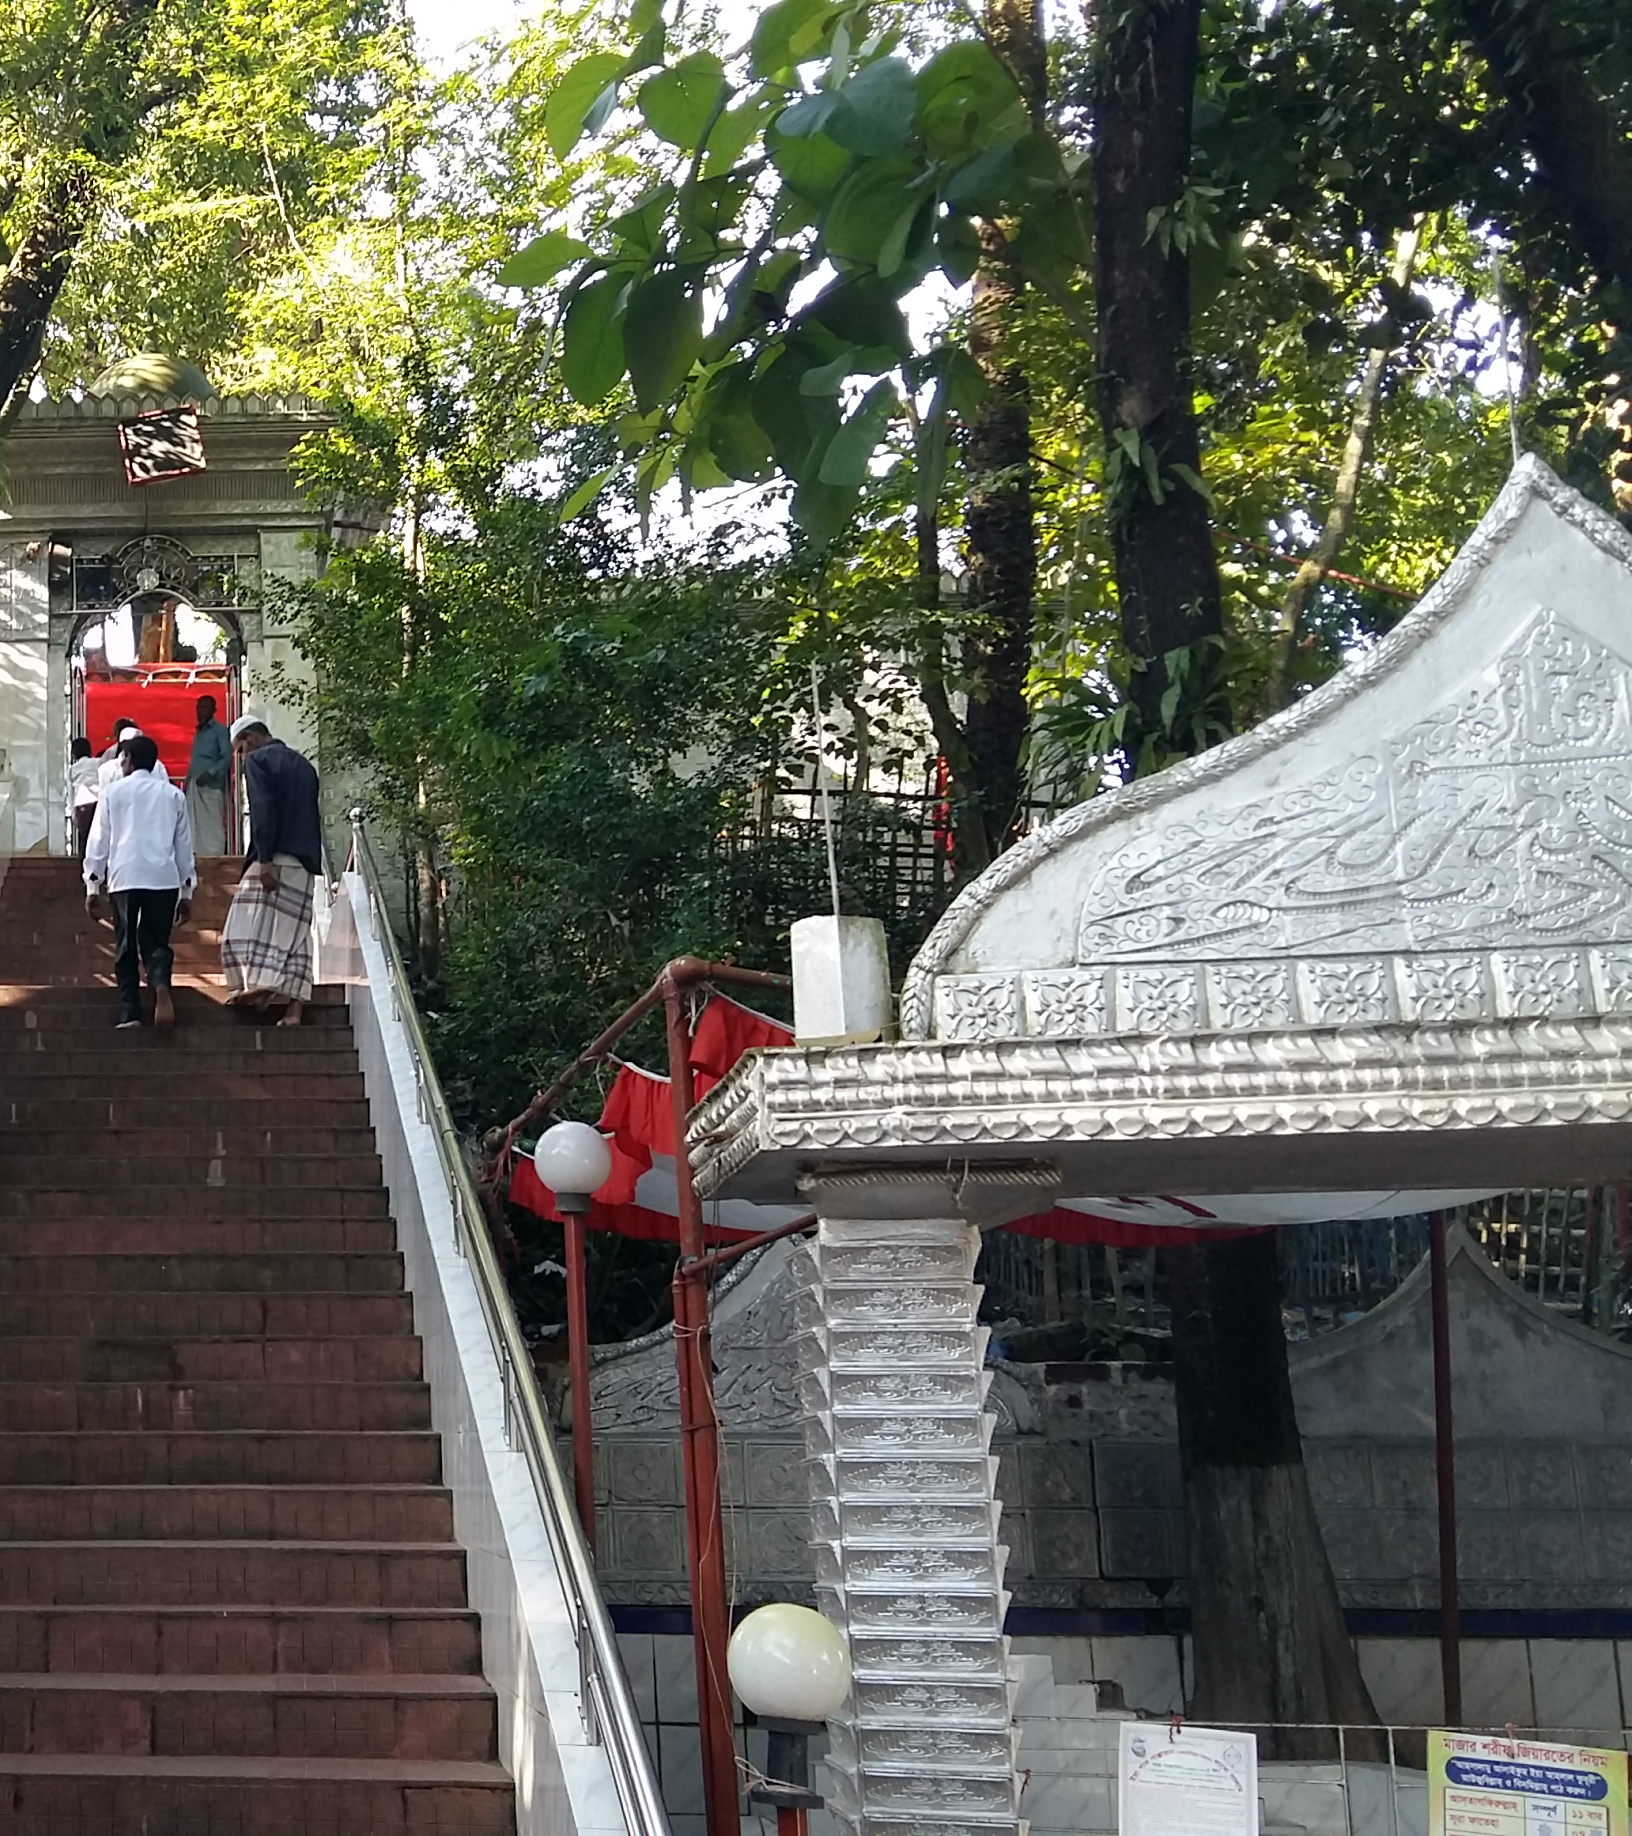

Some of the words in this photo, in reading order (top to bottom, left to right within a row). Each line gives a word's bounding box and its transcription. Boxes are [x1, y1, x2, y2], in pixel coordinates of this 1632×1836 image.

[1442, 1737, 1477, 1753] মাজার
[1516, 1742, 1575, 1763] জিয়ারতের
[1579, 1749, 1608, 1768] নিয়ম
